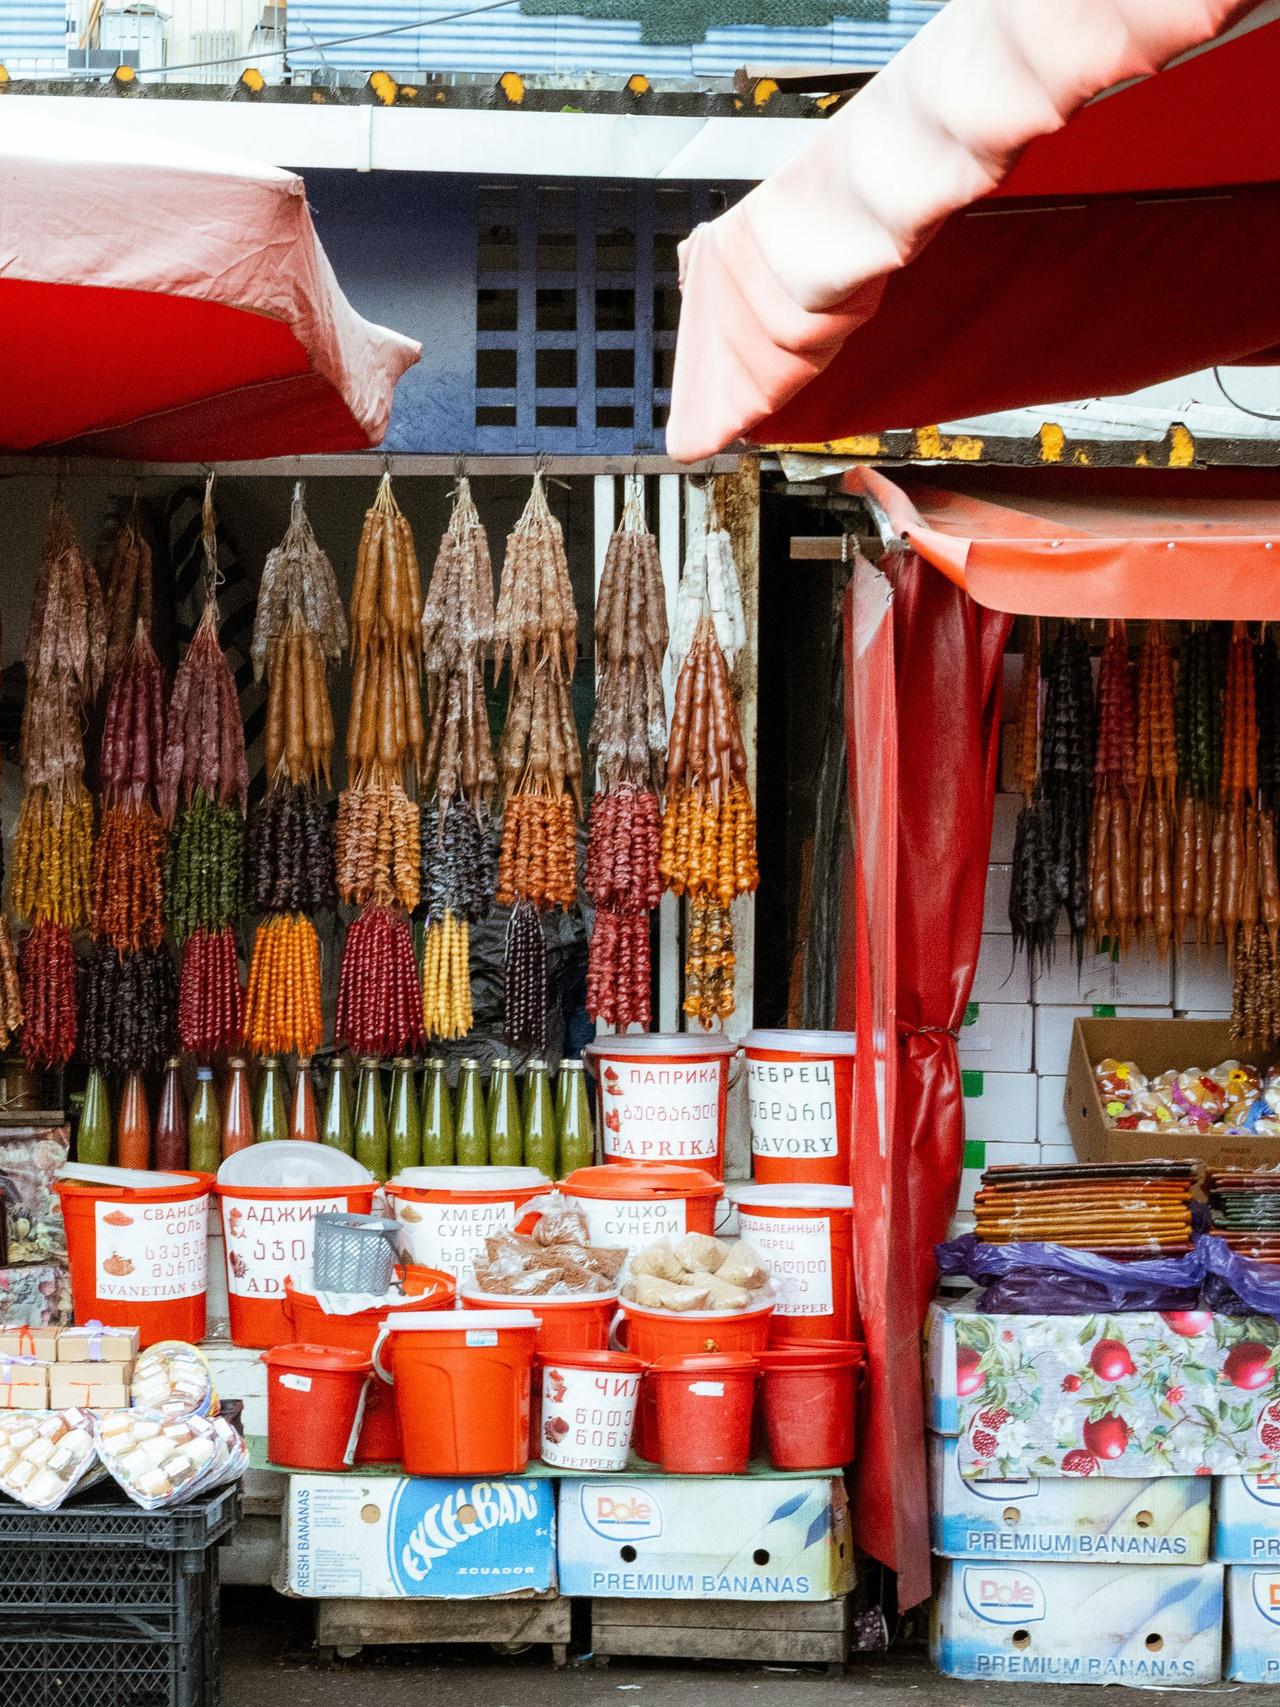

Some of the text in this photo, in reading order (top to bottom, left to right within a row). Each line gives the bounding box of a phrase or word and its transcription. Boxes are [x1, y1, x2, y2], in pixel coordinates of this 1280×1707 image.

[631, 1068, 717, 1084] ПАПРИКА
[612, 1137, 716, 1156] PAPRIKA
[753, 1136, 833, 1153] SAVORY
[440, 1208, 506, 1221] ХМЕЛИ
[615, 1205, 667, 1220] УЦХО
[166, 1219, 201, 1235] СОЛЬ
[605, 1221, 678, 1234] СУНЕЛИ
[760, 1239, 795, 1251] ПЕРЕЦ
[100, 1283, 187, 1296] SVANETIAN
[775, 1303, 828, 1314] PEPPER
[562, 1456, 614, 1469] PEPPER
[597, 1497, 651, 1521] Dole
[297, 1489, 310, 1550] BANANAS
[969, 1532, 1187, 1555] PREMIUM BANANAS
[457, 1566, 535, 1575] ECUADOR
[593, 1573, 809, 1593] PREMIUM BANANAS
[980, 1580, 1035, 1604] Dole
[977, 1655, 1195, 1677] PREMIUM BANANAS
